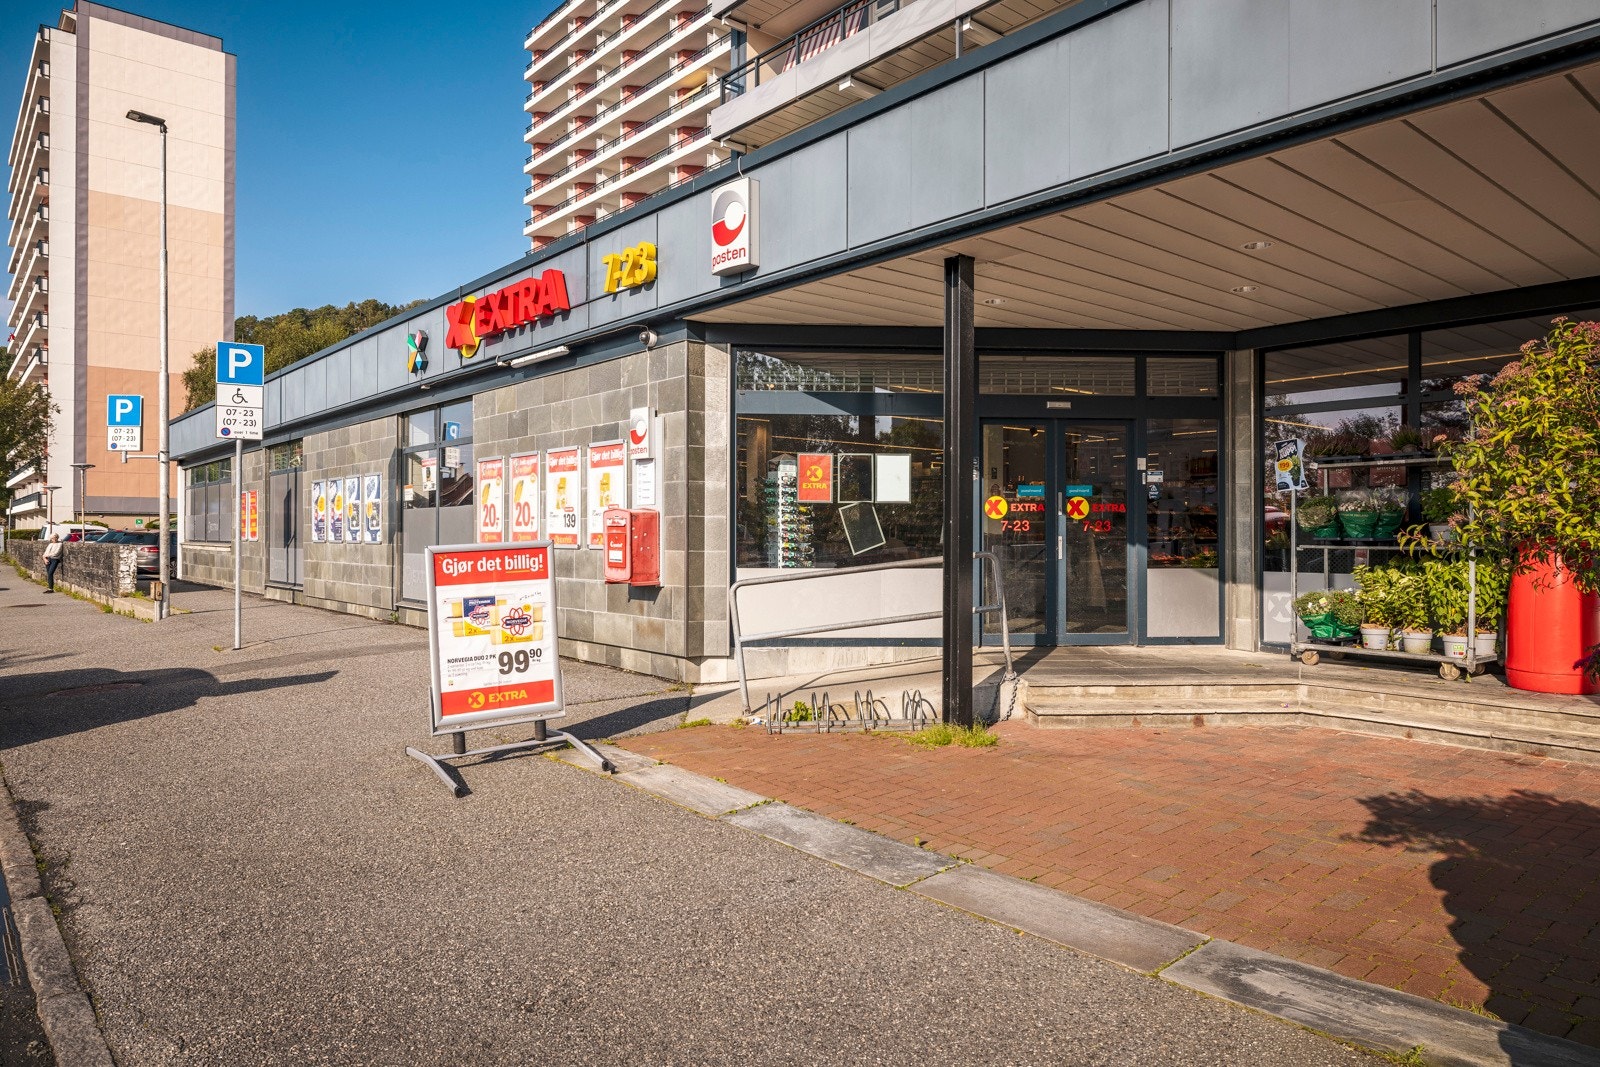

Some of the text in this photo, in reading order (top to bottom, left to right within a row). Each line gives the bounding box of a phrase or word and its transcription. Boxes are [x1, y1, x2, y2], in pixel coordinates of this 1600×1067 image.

[712, 247, 747, 270] posten
[602, 241, 657, 293] 7-23
[475, 269, 570, 338] EXTRA
[228, 347, 253, 379] P
[115, 398, 134, 423] P
[225, 408, 237, 416] 07
[243, 409, 254, 417] 23
[222, 417, 237, 426] (07
[243, 418, 257, 428] 23)
[802, 482, 828, 490] EXTRA
[1010, 503, 1045, 512] EXTRA
[1091, 502, 1127, 513] EXTRA
[563, 513, 576, 528] 139
[1000, 520, 1030, 532] 7-23
[1083, 520, 1112, 532] 7-23
[442, 553, 544, 577] Gjør det billig!
[529, 647, 542, 659] 90
[447, 656, 473, 664] NORVEGIA
[498, 649, 530, 675] 99
[488, 689, 528, 703] EXTRA
